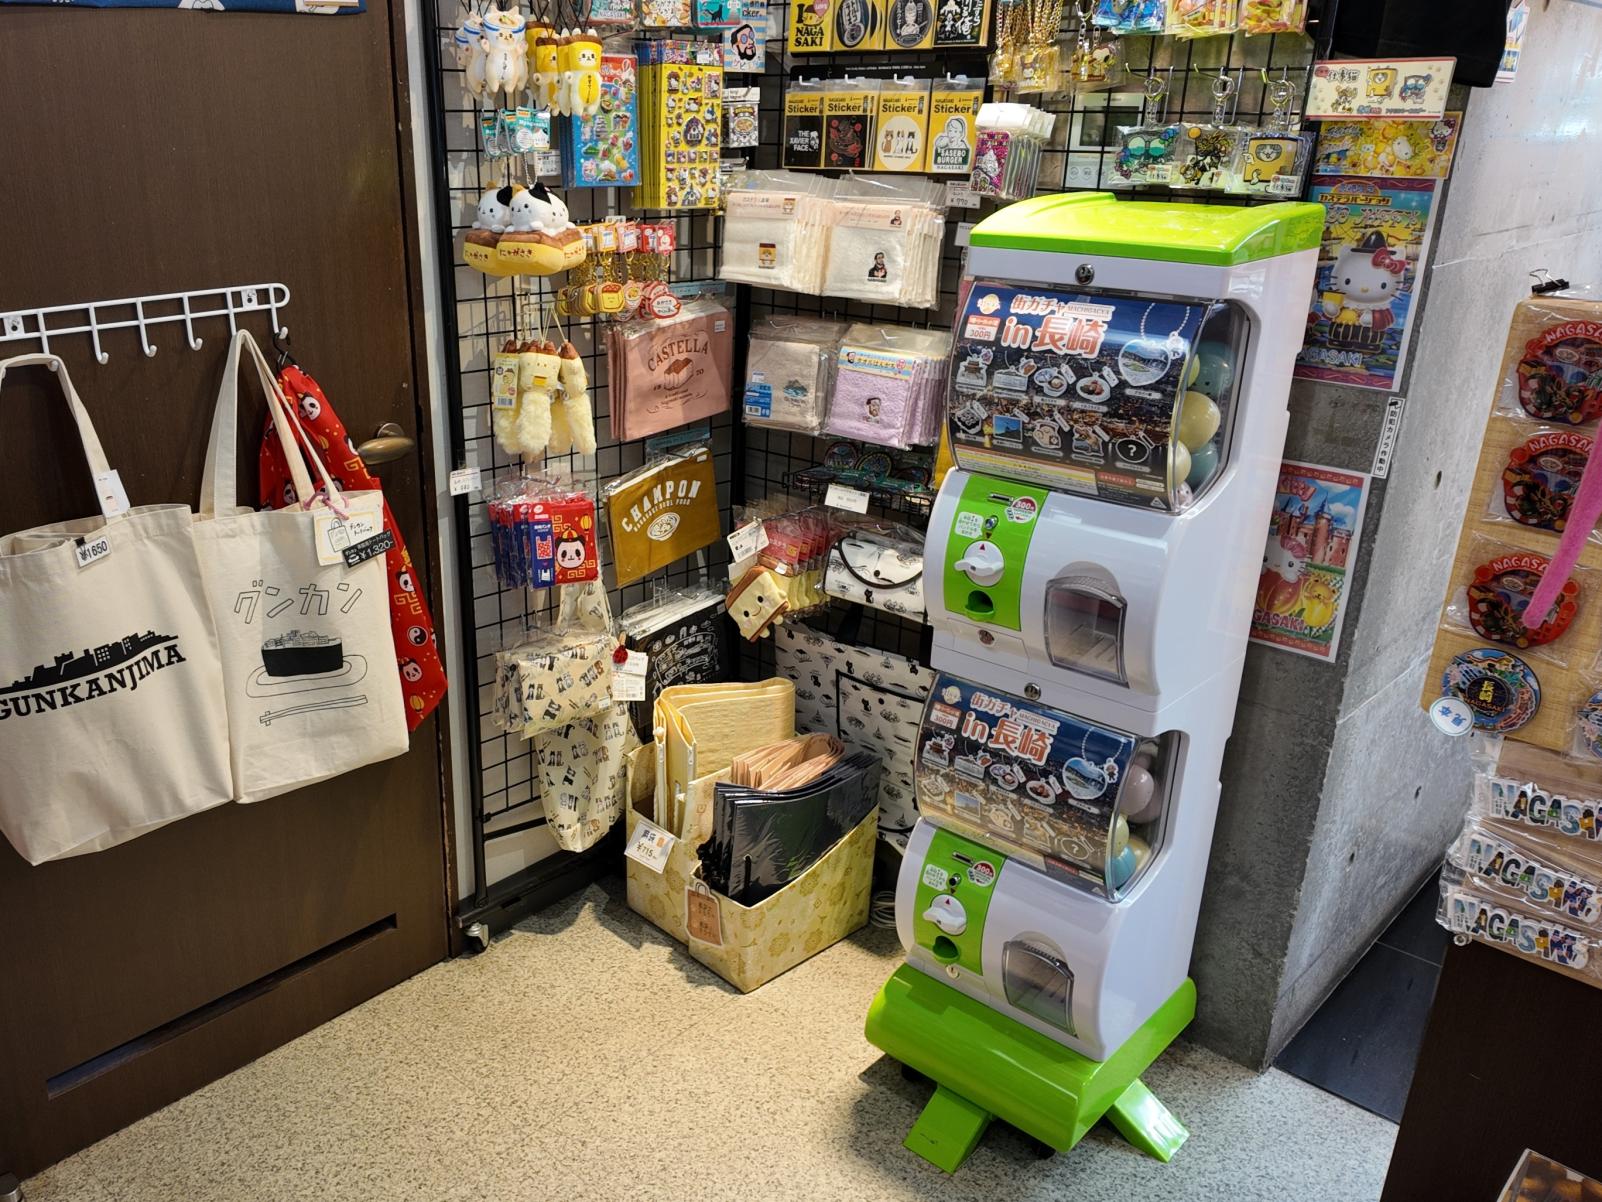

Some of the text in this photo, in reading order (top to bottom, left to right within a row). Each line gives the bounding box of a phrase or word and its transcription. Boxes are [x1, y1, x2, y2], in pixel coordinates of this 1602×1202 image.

[796, 27, 824, 37] NAGA
[795, 37, 823, 47] SAKI
[787, 105, 818, 114] Sticker
[828, 103, 861, 113] Sticker
[882, 104, 917, 113] Sticker
[934, 104, 972, 114] Sticker
[798, 130, 810, 138] THE
[647, 338, 709, 372] CASTELLA
[1300, 349, 1363, 367] AGASAKI
[621, 480, 701, 532] CHAMPON
[79, 540, 108, 561] ¥1650
[234, 579, 363, 625] グンカン
[0, 644, 187, 721] GUNKANJIMA
[1479, 681, 1494, 703] 長崎
[934, 714, 954, 728] 300円
